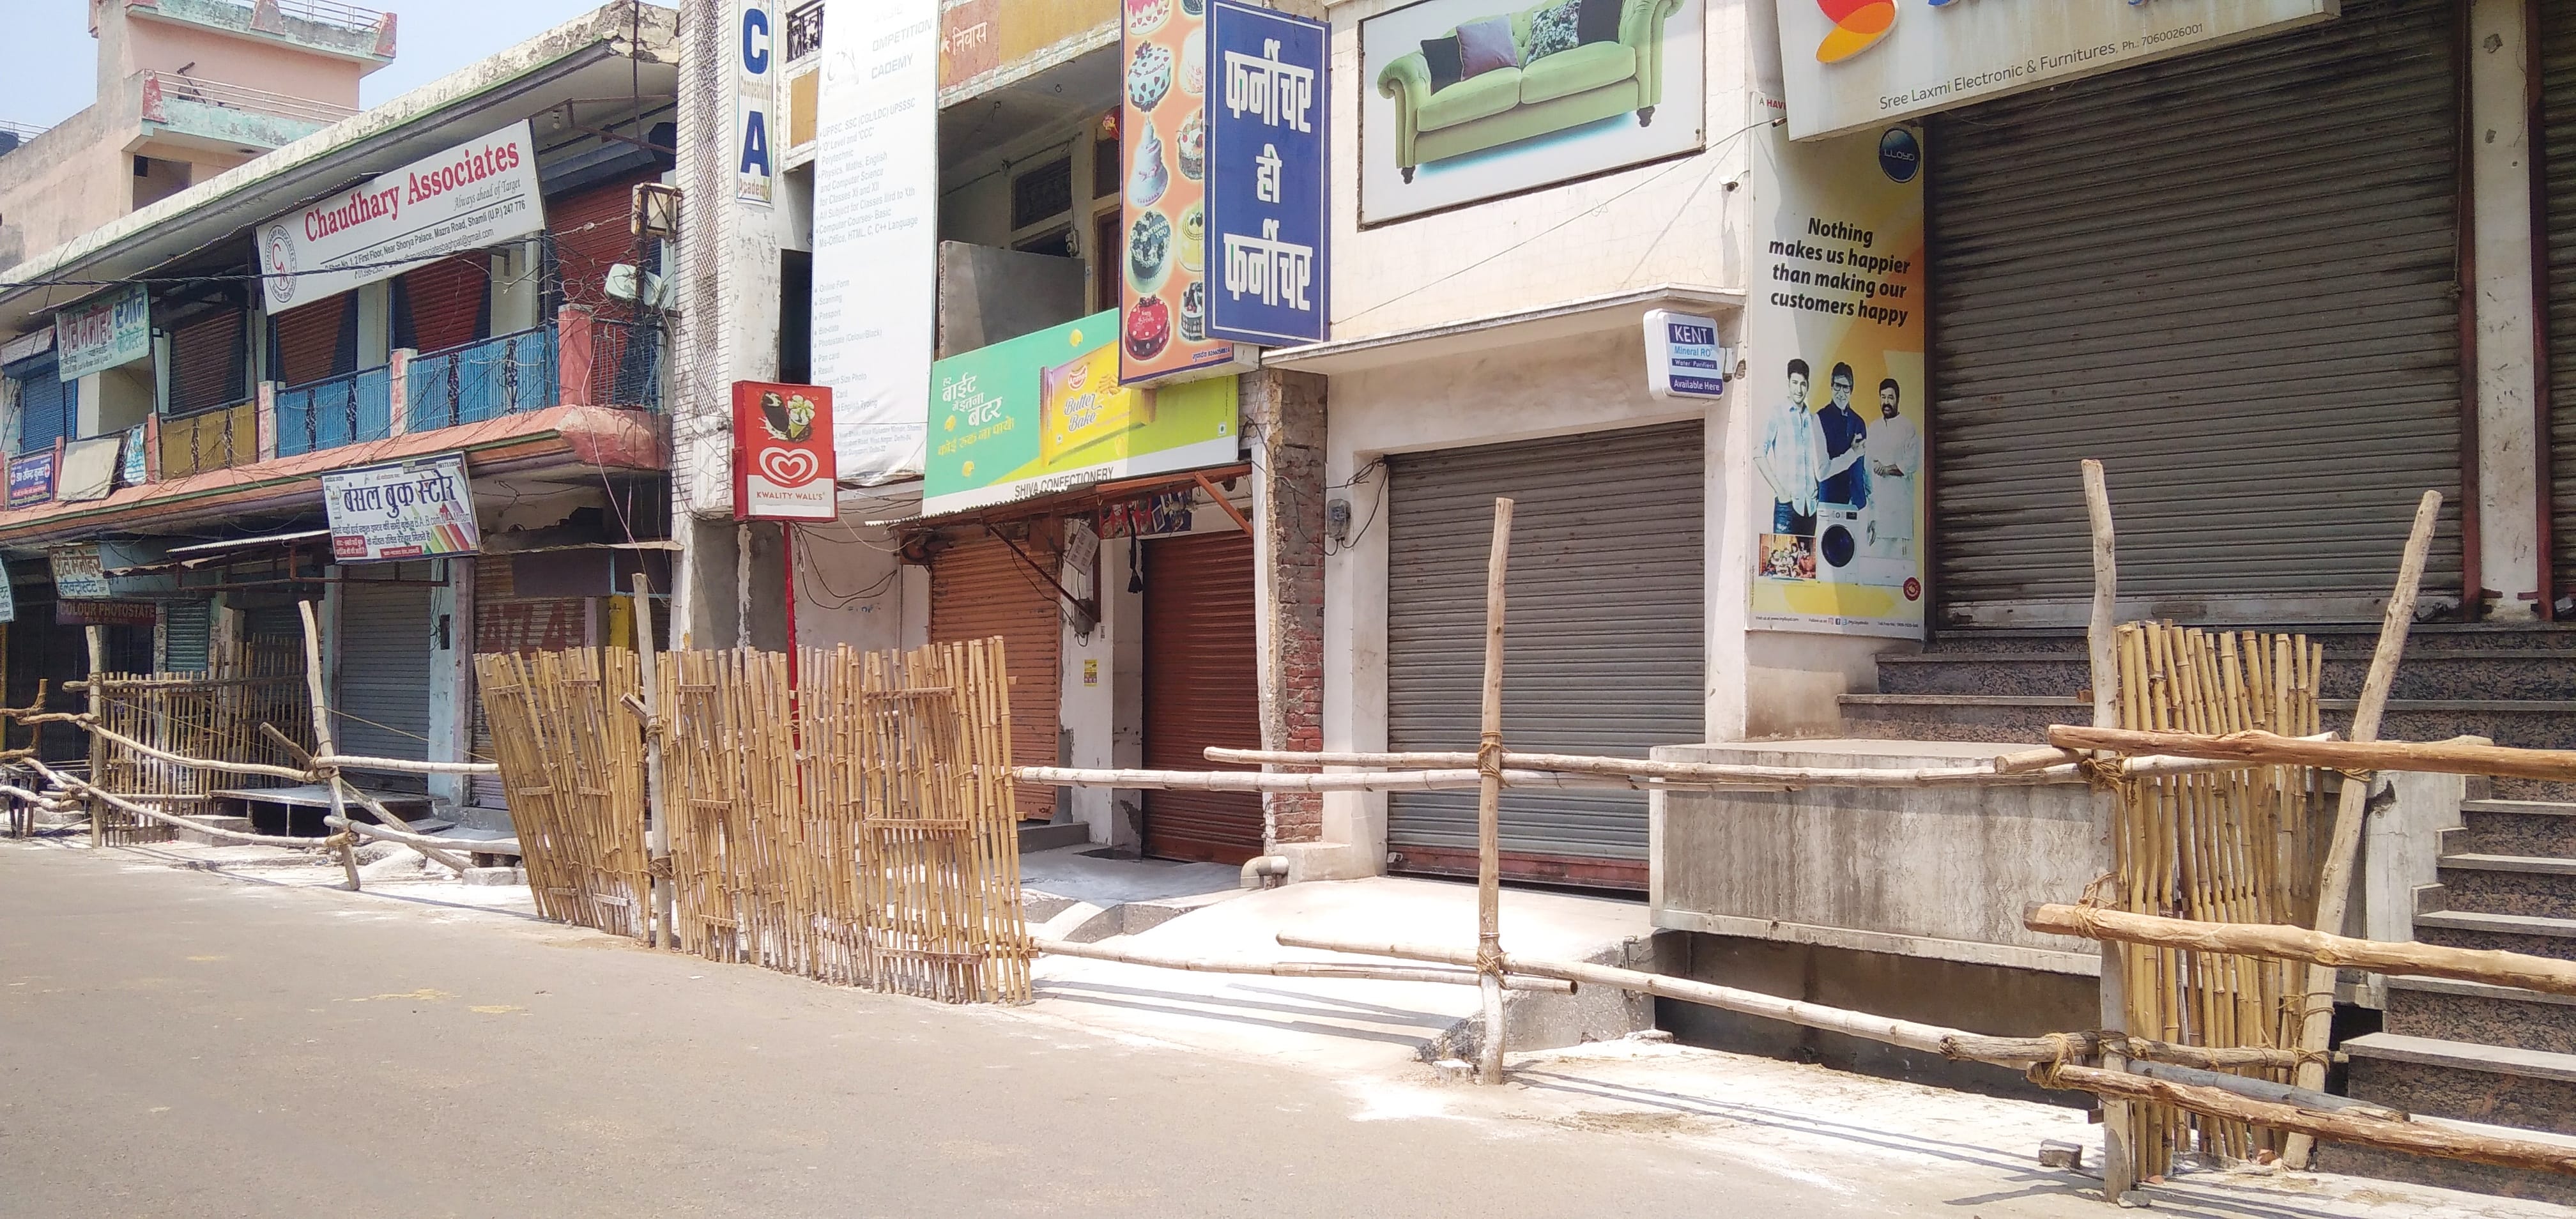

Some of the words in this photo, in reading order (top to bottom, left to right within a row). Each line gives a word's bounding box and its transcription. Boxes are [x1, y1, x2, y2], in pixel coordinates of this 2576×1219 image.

[743, 8, 769, 74] C
[952, 21, 987, 56] निवास
[1880, 94, 1908, 109] Sree
[1911, 81, 1951, 102] Laxmi
[1955, 65, 2023, 91] Electronic
[2027, 60, 2036, 73] &
[2041, 43, 2119, 70] Furnitures,
[2142, 24, 2203, 46] 7060026001
[1225, 38, 1314, 134] फर्नीचर
[890, 97, 916, 115] UPSSSC
[1767, 99, 1786, 110] HAV
[740, 111, 770, 177] A
[1884, 149, 1915, 161] LLOYD
[1255, 143, 1282, 203] ही
[305, 185, 400, 242] Chaudhary
[408, 142, 519, 205] Associates
[454, 193, 476, 211] Always
[477, 187, 493, 201] ahead
[494, 183, 502, 199] of
[501, 178, 521, 194] Target
[468, 211, 487, 226] Shamli
[503, 204, 514, 215] 247
[514, 199, 526, 211] 776
[1807, 217, 1873, 248] Nothing
[1223, 218, 1313, 311] फर्नीचर
[1768, 240, 1823, 261] makes
[1827, 249, 1844, 266] us
[1847, 249, 1911, 275] happier
[1772, 263, 1811, 285] than
[1814, 273, 1876, 299] making
[1880, 280, 1907, 299] our
[1770, 289, 1855, 316] customers
[1858, 300, 1908, 327] happy
[1675, 325, 1706, 344] KENT
[1675, 346, 1698, 356] Mineral
[1693, 360, 1714, 369] Purifiers
[942, 372, 977, 401] बाईट
[1674, 379, 1703, 390] Available
[1705, 381, 1720, 391] Here
[967, 396, 1002, 426] बटर
[1064, 393, 1102, 415] Butter
[1069, 409, 1096, 431] Bake
[938, 436, 956, 456] कोई
[342, 482, 382, 512] बंसल
[383, 482, 414, 518] बुक
[416, 469, 456, 504] स्टोर
[756, 491, 792, 500] KWALITY
[795, 493, 823, 501] WALL'S
[1015, 482, 1038, 497] SHIVA
[1041, 466, 1114, 489] CONFECTIONERY
[99, 602, 155, 618] PHOTOSTATE
